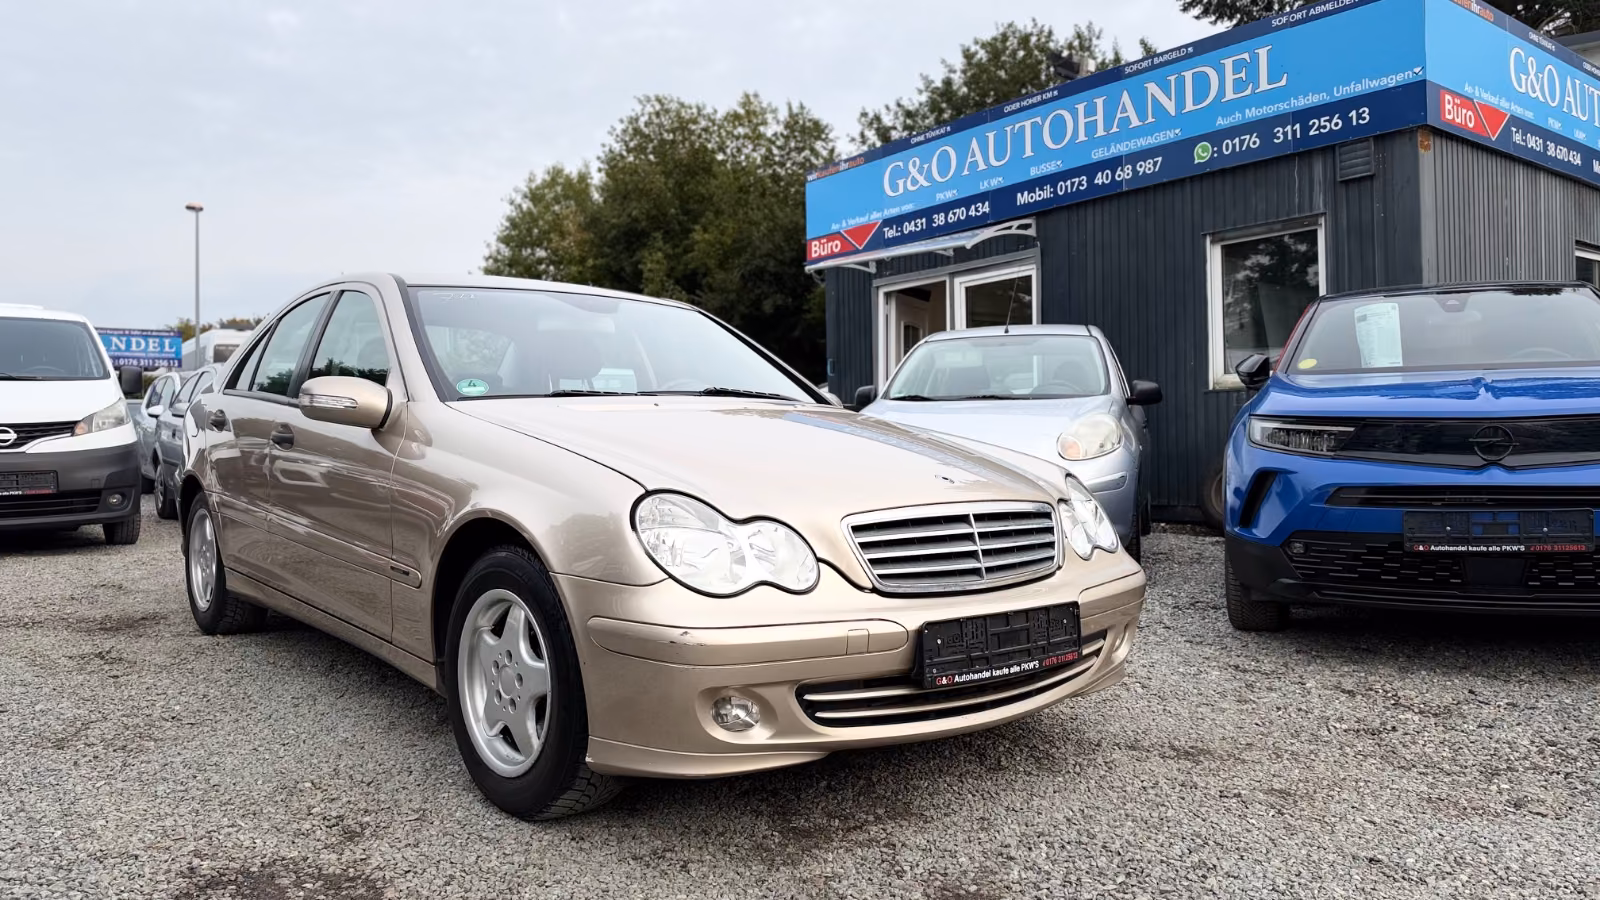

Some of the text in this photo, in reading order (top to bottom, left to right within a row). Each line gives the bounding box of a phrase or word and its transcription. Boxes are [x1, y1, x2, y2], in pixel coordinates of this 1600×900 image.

[1271, 10, 1308, 27] SOFORT
[1124, 48, 1186, 74] SOFORT BARGELD
[1509, 47, 1560, 108] G&O
[1003, 101, 1020, 113] ODER
[1042, 91, 1053, 101] KM
[1215, 70, 1413, 127] Auch Motorschäden, Unfallwagen
[1444, 93, 1475, 129] Büro
[883, 44, 1288, 197] G&O AUTOHANDEL
[1222, 106, 1371, 155] 0176 311 256 13
[1091, 129, 1175, 160] GELÄNDEWAGEN
[1511, 126, 1526, 146] Tel.:
[1526, 133, 1544, 153] 0431
[1546, 140, 1556, 158] 38
[1556, 145, 1569, 162] 670
[1568, 150, 1582, 167] 434
[1029, 160, 1058, 177] BUSSE
[883, 156, 1163, 240] Tel.: 0431 38 670 434 Mobil: 0173 40 68 987
[811, 238, 841, 258] Büro
[104, 336, 177, 352] NDEL
[936, 675, 953, 685] G&O
[954, 668, 991, 683] Autohandel
[992, 666, 1009, 677] kaufe
[1009, 664, 1021, 673] alle
[1020, 660, 1040, 672] PKW'S
